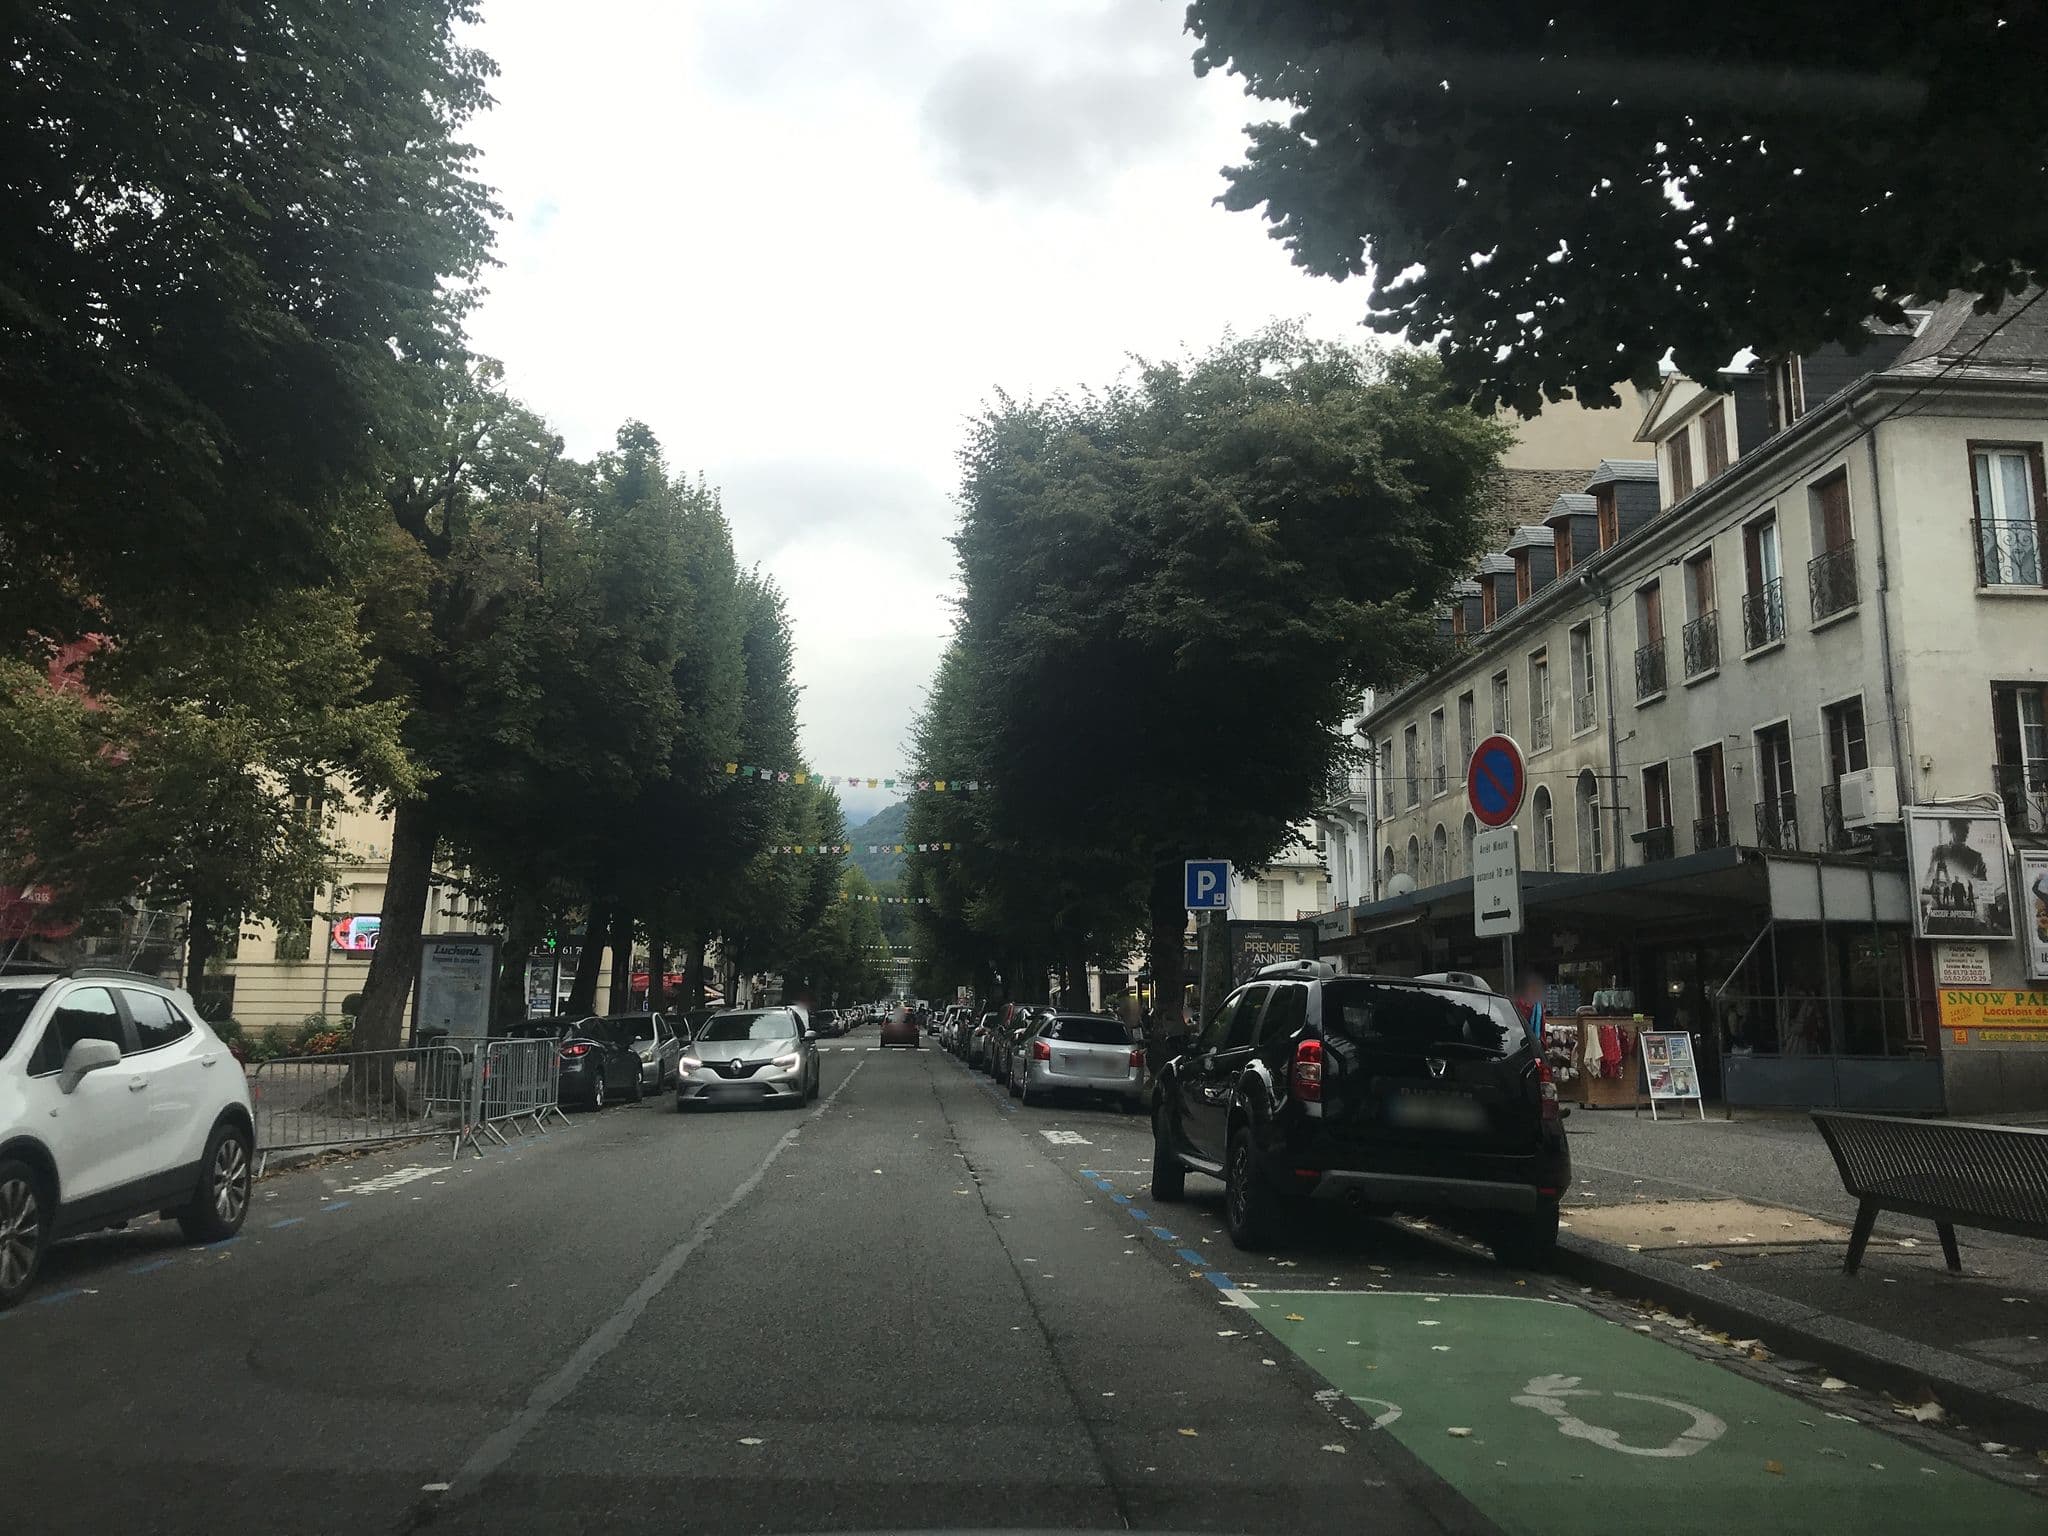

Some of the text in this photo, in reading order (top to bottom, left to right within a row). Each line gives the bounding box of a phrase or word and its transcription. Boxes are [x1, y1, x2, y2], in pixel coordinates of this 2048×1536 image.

[1197, 870, 1217, 900] P
[1947, 991, 2006, 1006] SNOW
[1984, 1006, 2033, 1016] Locations
